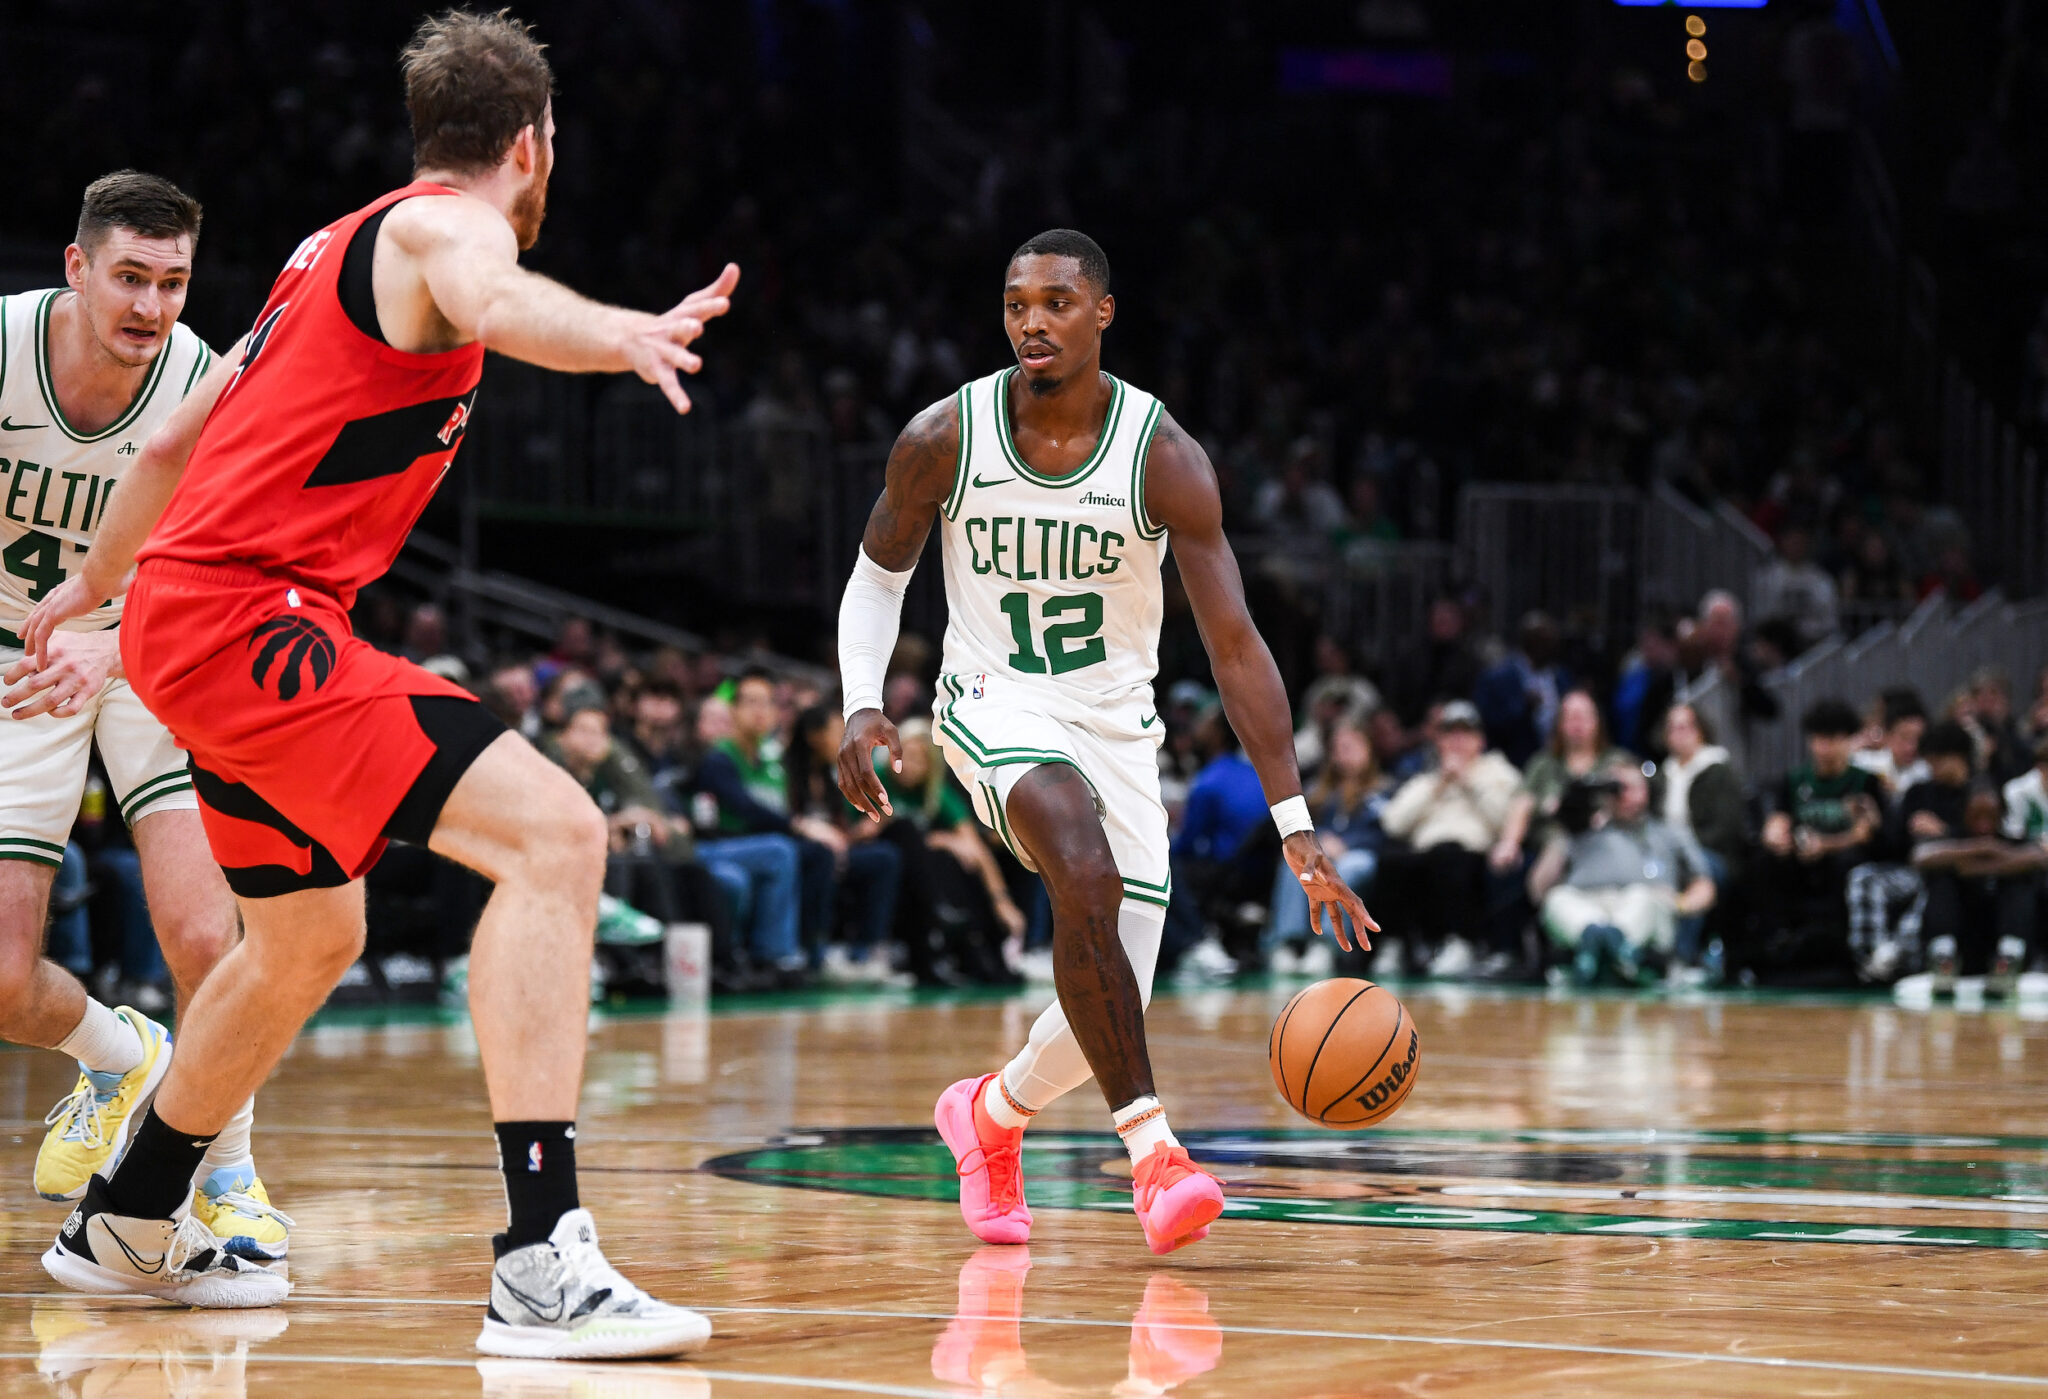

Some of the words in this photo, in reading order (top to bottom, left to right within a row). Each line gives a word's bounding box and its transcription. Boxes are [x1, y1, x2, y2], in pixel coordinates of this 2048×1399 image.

[0, 457, 118, 532] ELTI
[1079, 491, 1125, 507] Amica
[3, 529, 112, 608] 4
[965, 517, 1125, 581] CELTICS
[1000, 592, 1107, 676] 12
[1355, 1028, 1418, 1111] Wilson
